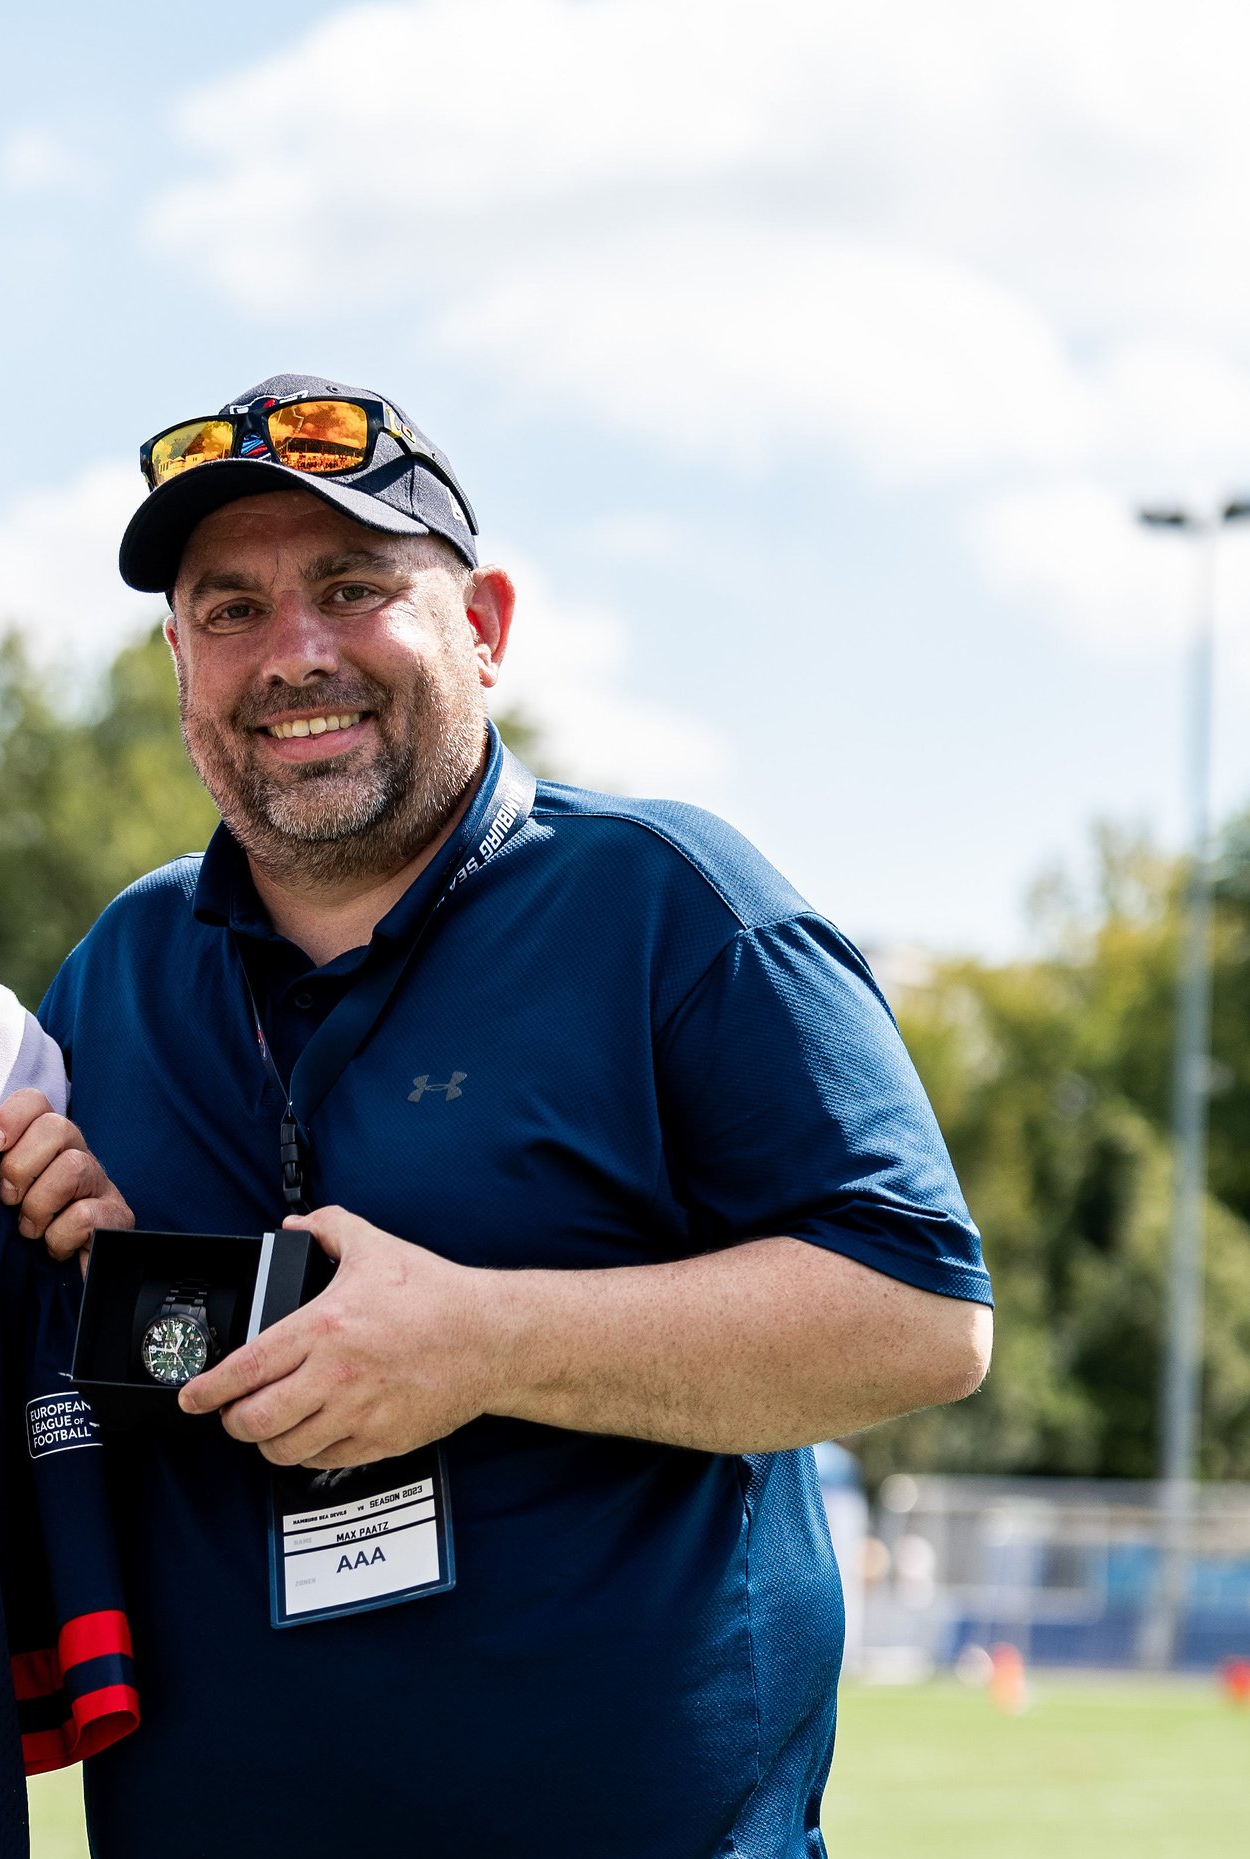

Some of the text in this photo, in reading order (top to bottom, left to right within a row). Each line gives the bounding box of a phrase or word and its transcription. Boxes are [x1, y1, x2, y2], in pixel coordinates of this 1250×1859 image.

[30, 1400, 91, 1422] EUROPEAN
[32, 1415, 72, 1435] LEAGUE
[33, 1426, 91, 1448] FOOTBALL
[369, 1492, 400, 1508] SEASON
[402, 1485, 423, 1498] 2023
[336, 1521, 389, 1543] MAX PAATZ
[336, 1546, 386, 1574] AAA
